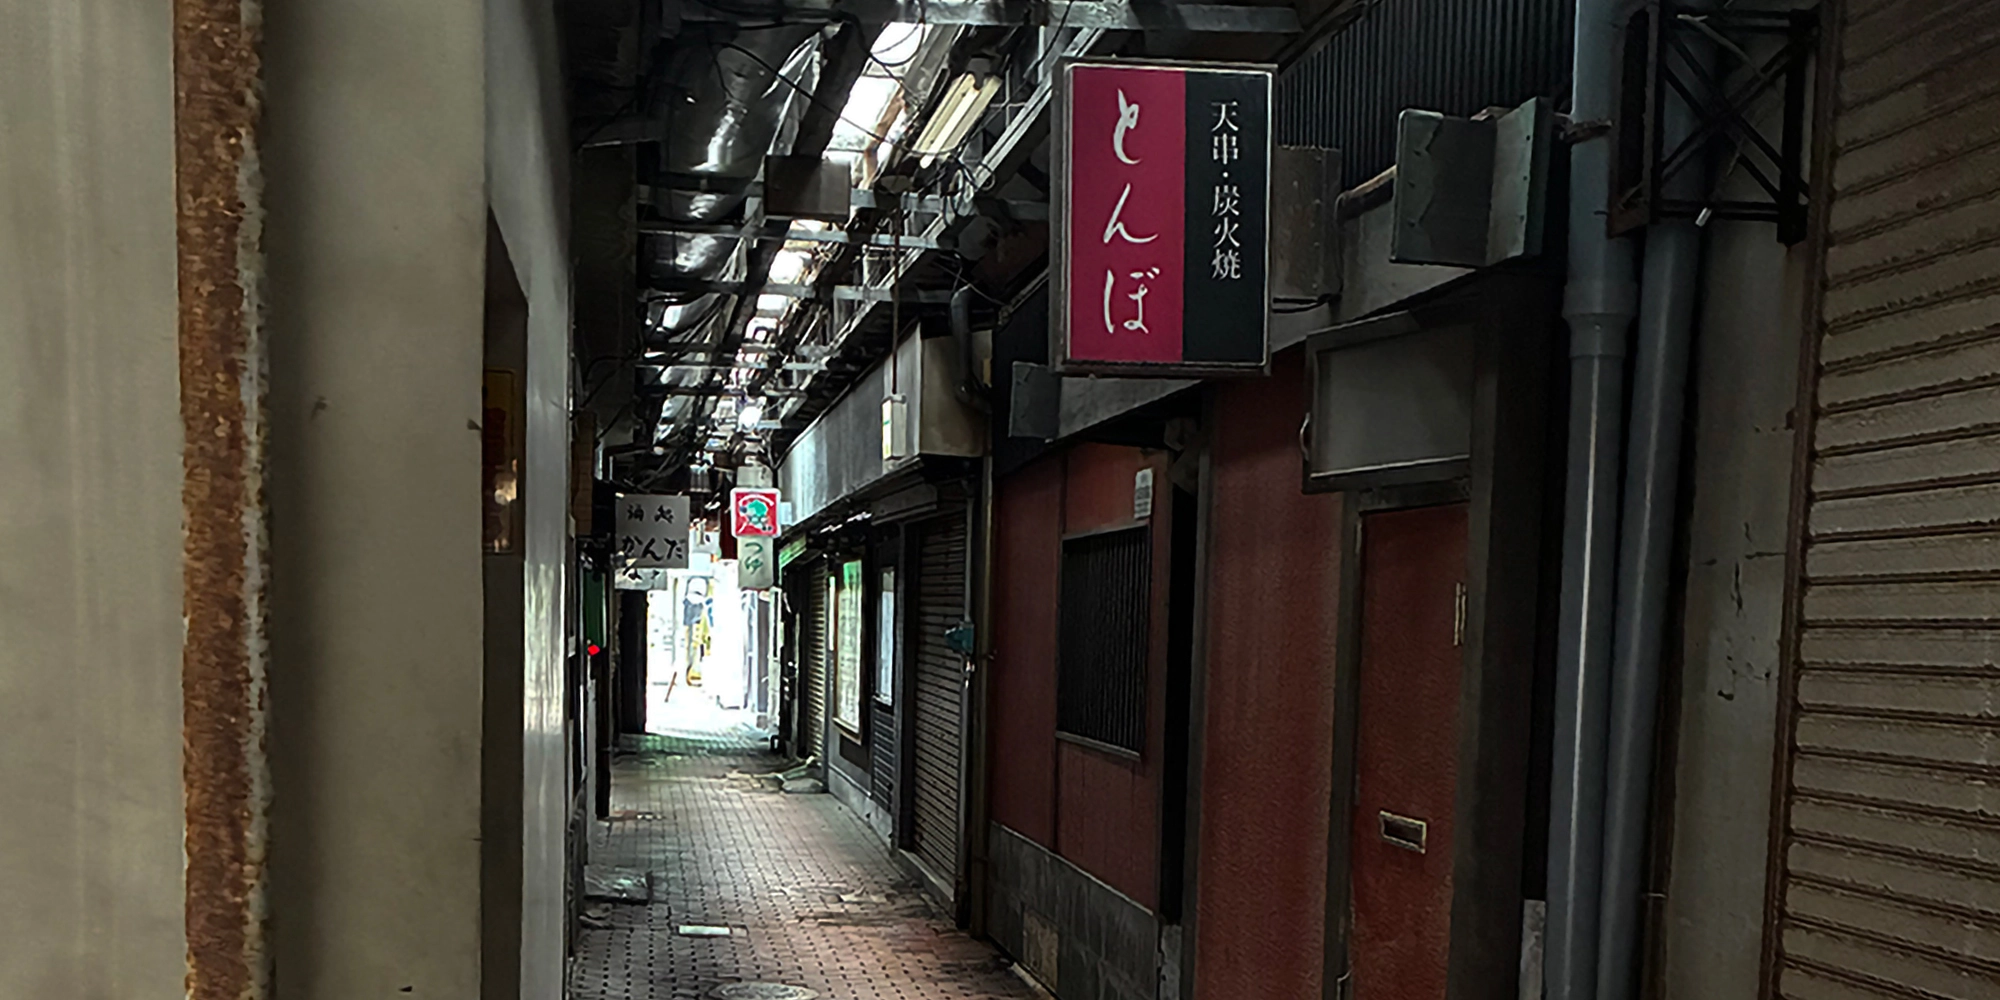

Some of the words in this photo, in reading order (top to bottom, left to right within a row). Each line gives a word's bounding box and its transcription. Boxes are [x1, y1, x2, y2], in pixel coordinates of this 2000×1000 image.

[1103, 88, 1160, 334] とんぼ
[1210, 101, 1241, 280] 天串・炭火焼
